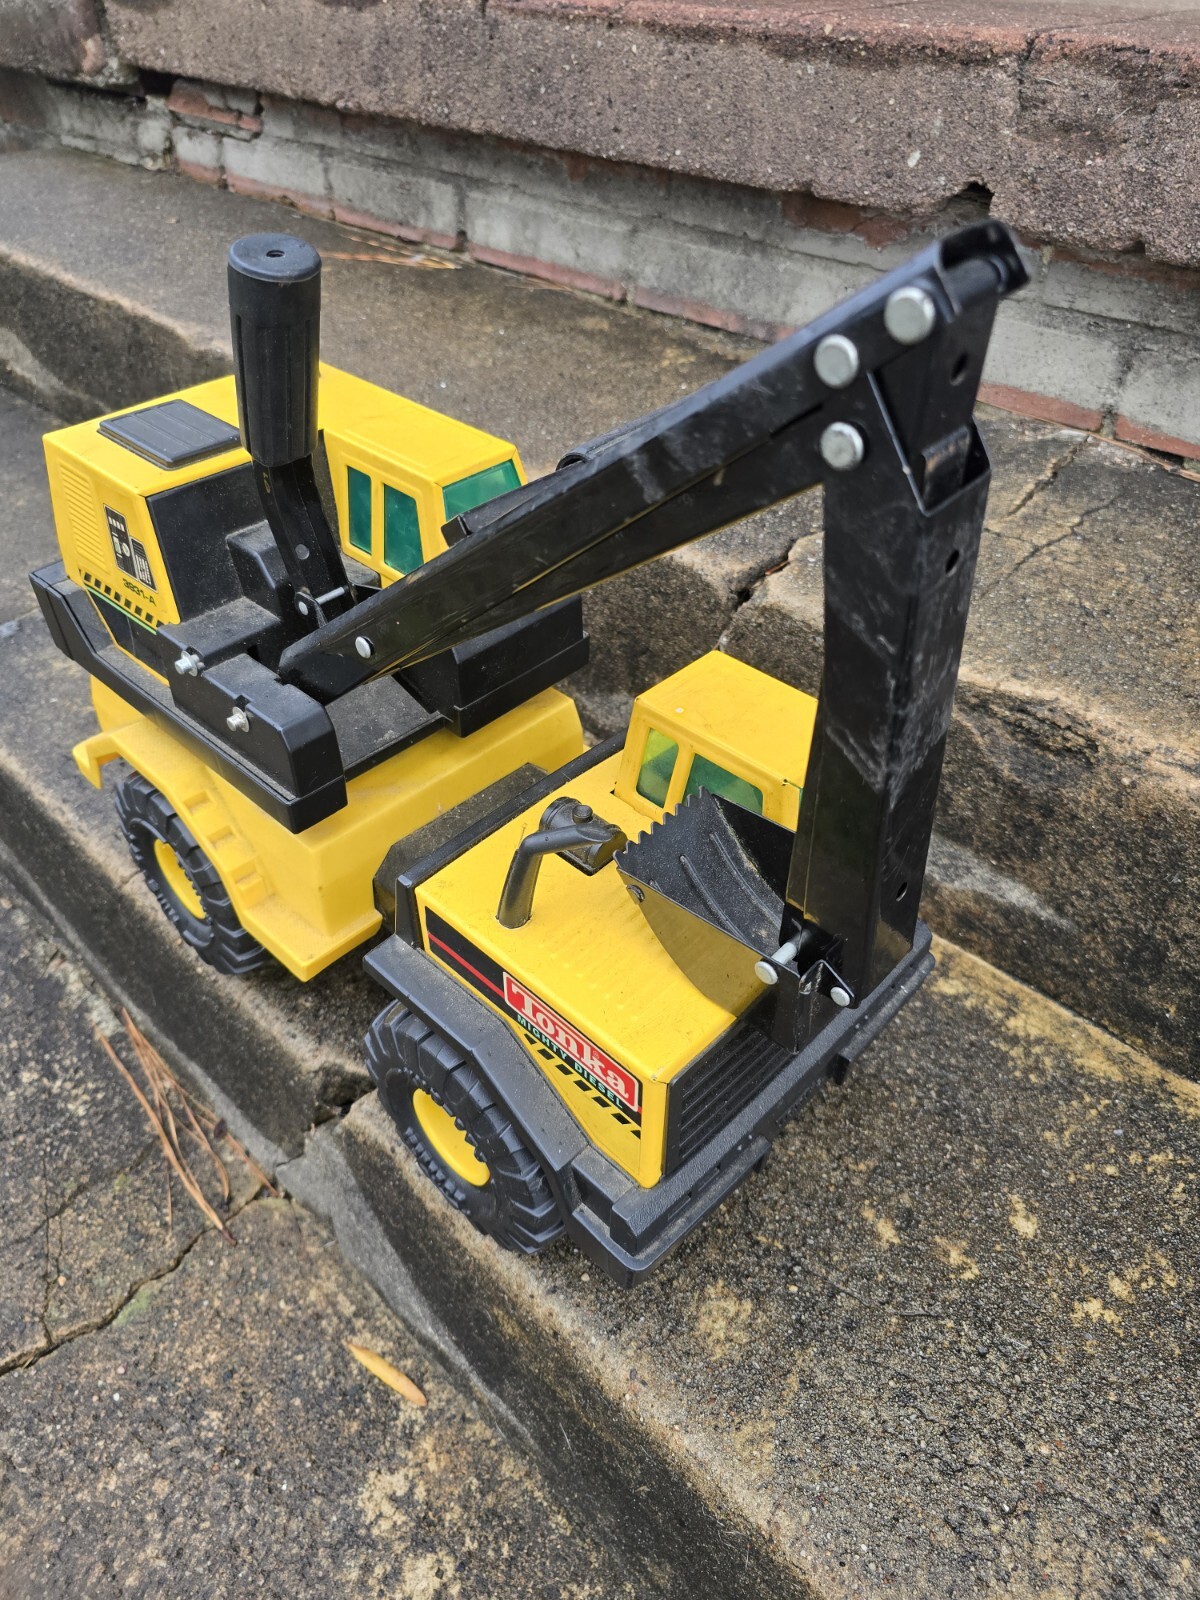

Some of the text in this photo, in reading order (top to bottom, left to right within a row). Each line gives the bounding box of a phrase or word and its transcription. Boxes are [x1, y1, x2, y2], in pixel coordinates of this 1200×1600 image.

[511, 982, 629, 1099] Tonka
[517, 1013, 623, 1109] MIGHTY DIESEL
